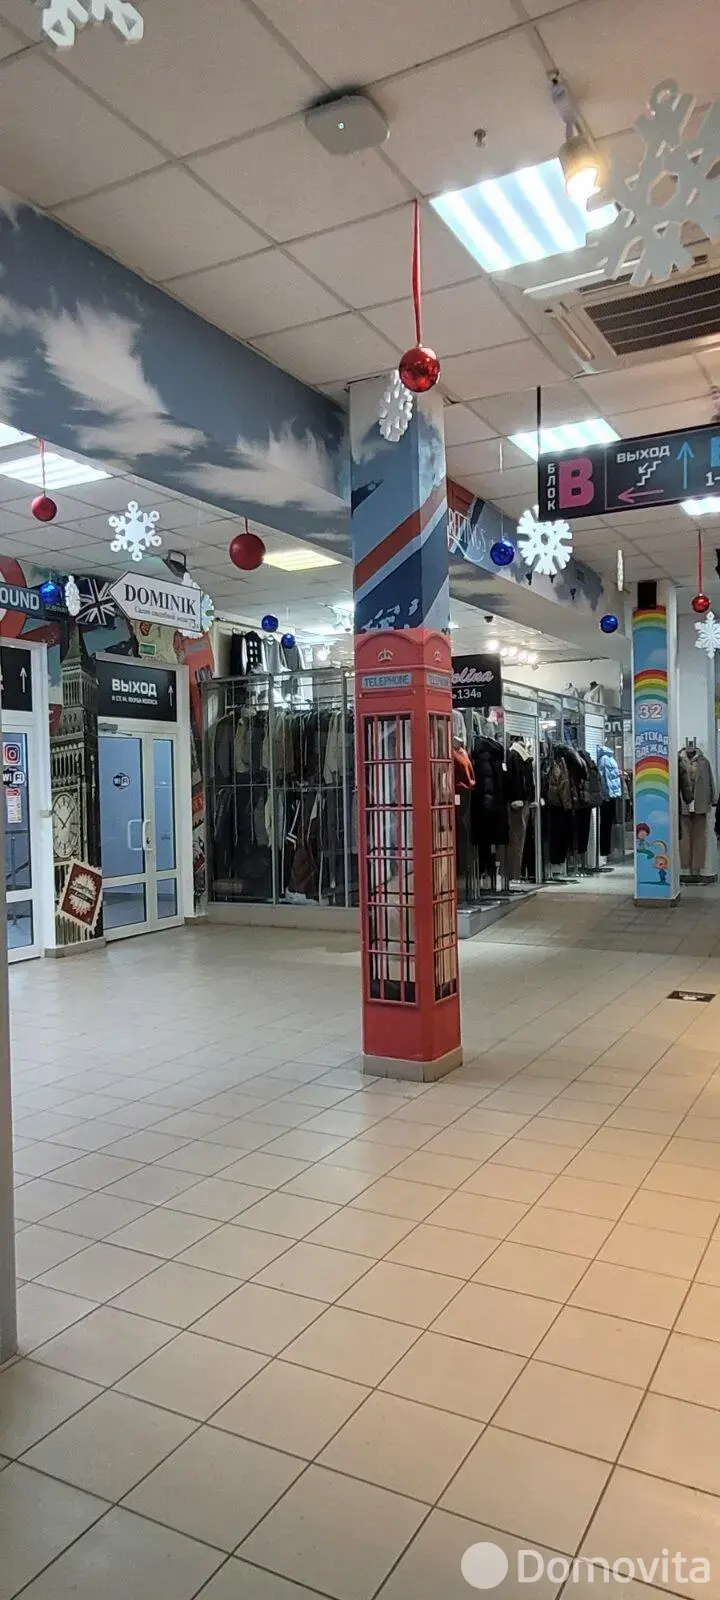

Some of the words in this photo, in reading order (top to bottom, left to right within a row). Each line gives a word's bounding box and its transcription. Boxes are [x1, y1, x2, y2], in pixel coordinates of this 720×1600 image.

[616, 445, 670, 464] ВЫХОД
[547, 463, 556, 511] БЛОК
[558, 456, 595, 509] В
[124, 583, 197, 616] DOMINIK
[364, 673, 411, 688] TELEPHONE
[451, 666, 495, 684] olina
[111, 678, 158, 698] ВЫХОД
[639, 703, 663, 719] 32
[636, 731, 669, 746] ДЕТСКАЯ
